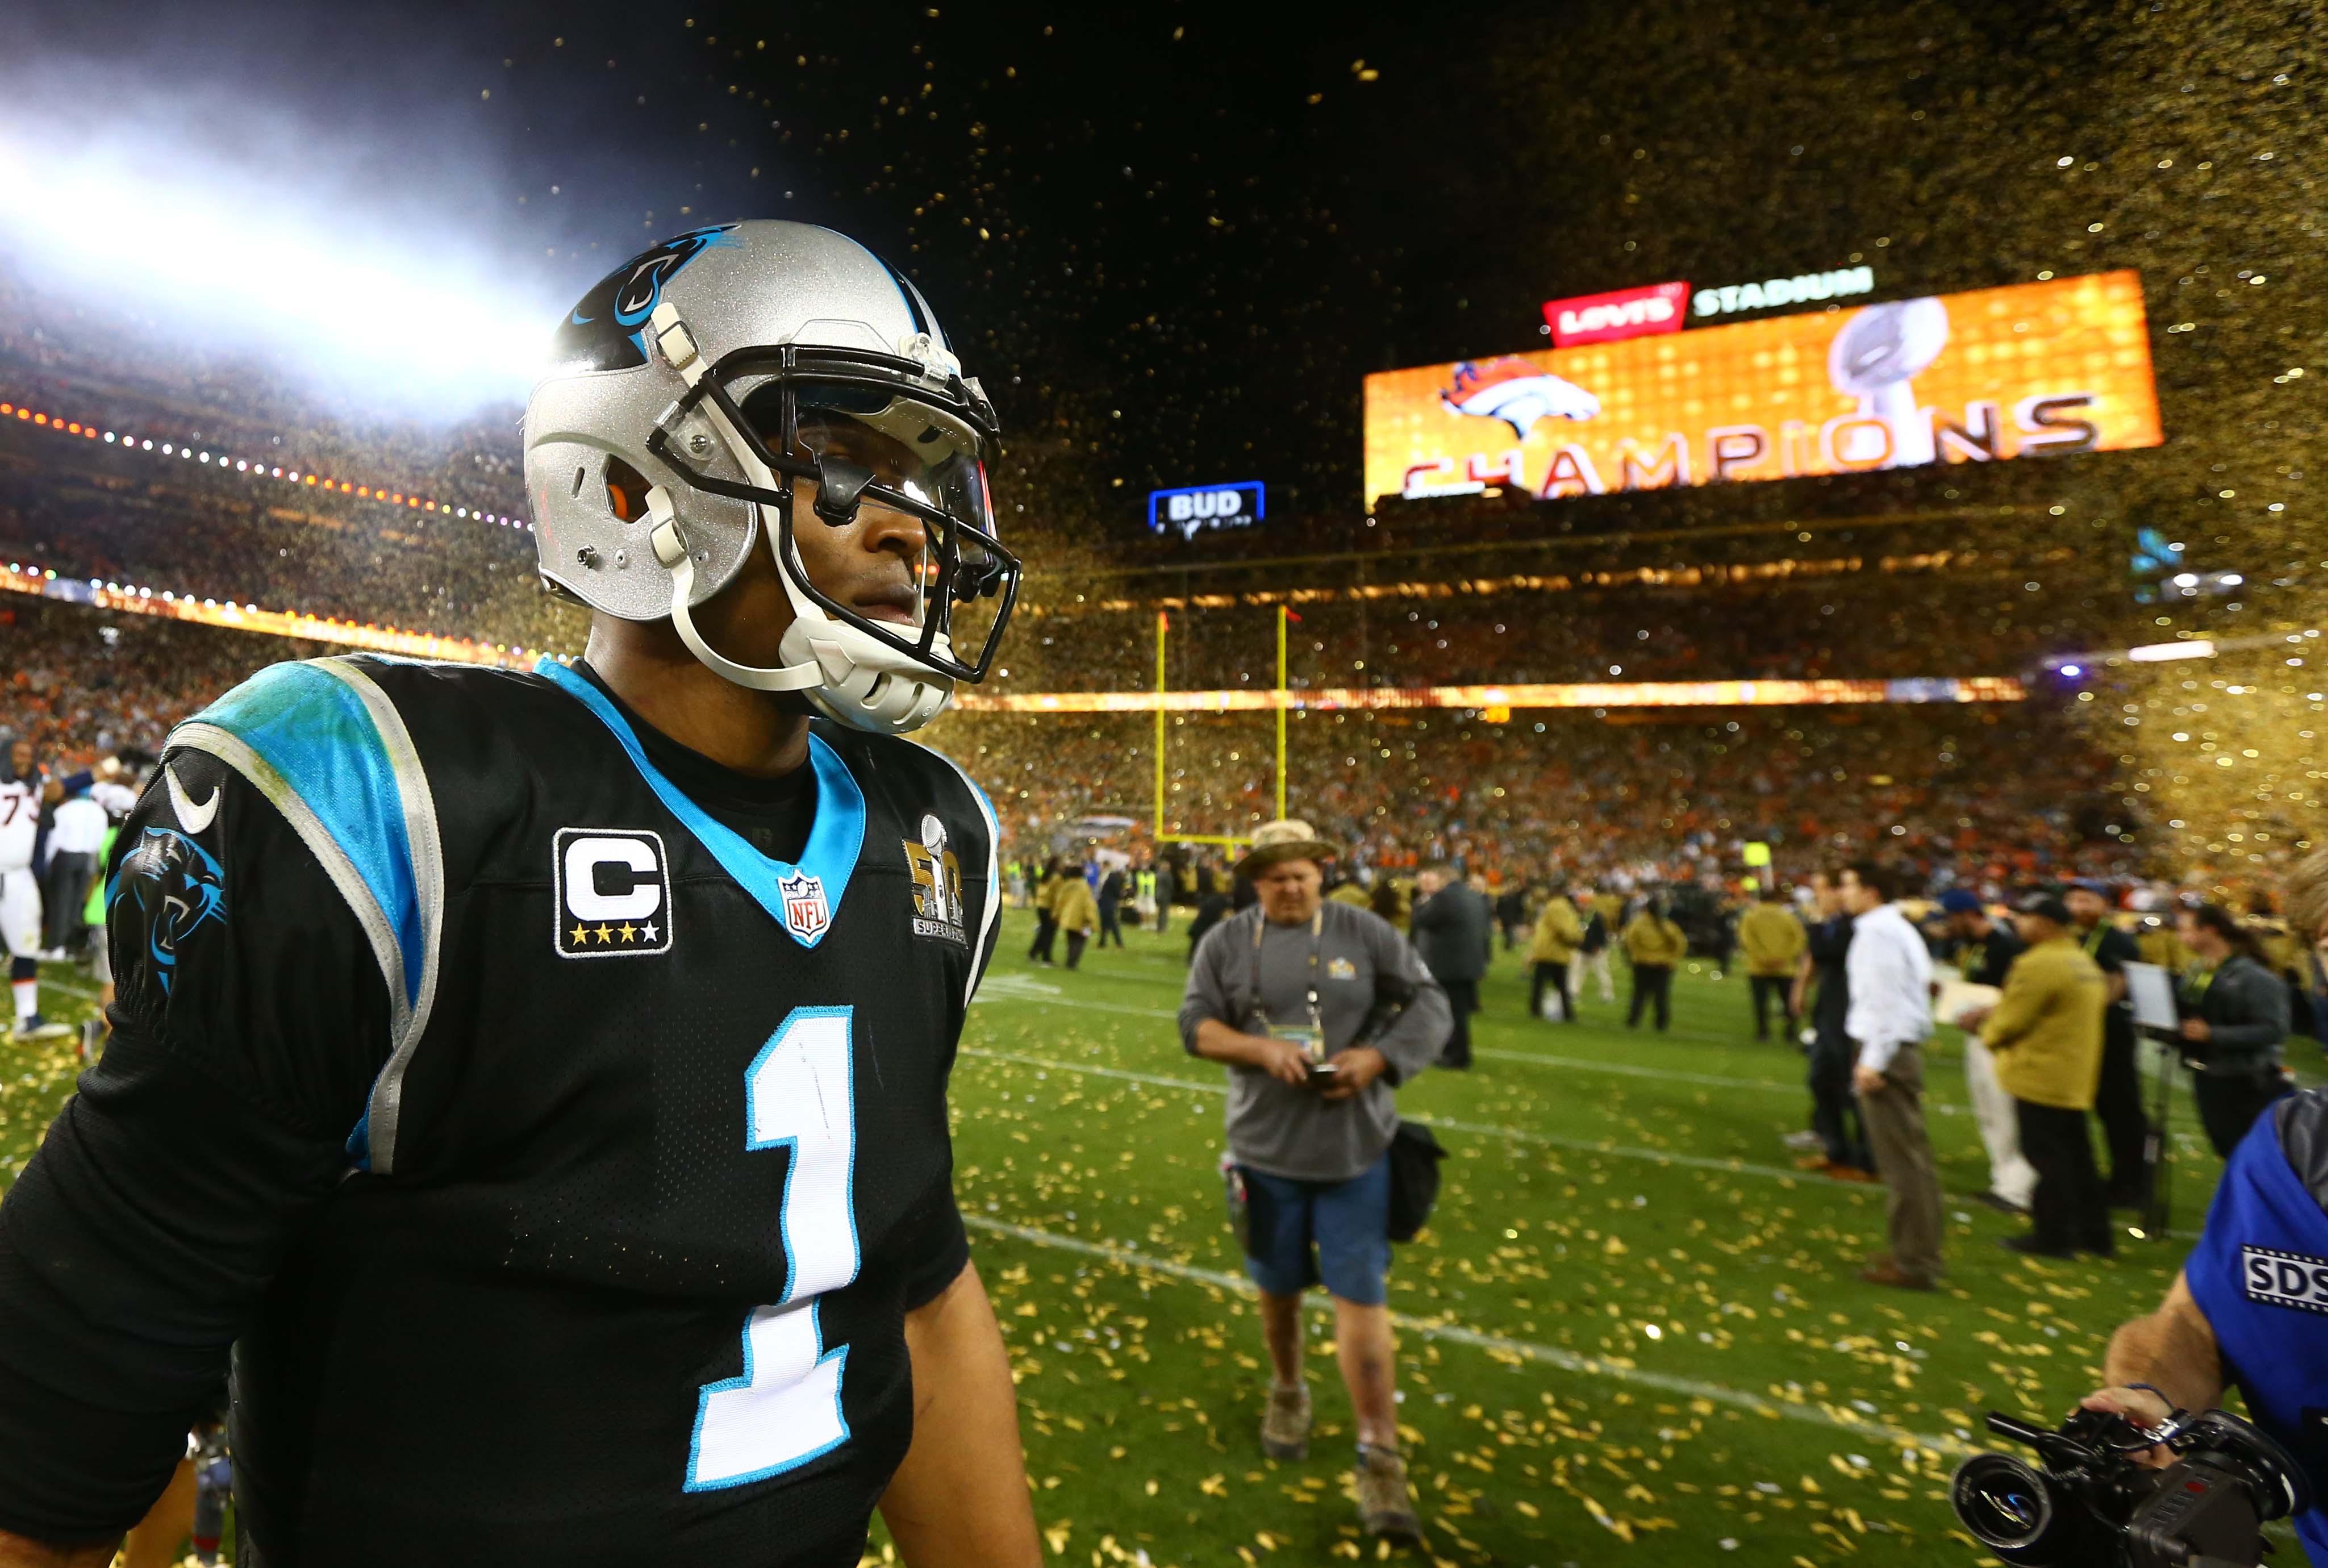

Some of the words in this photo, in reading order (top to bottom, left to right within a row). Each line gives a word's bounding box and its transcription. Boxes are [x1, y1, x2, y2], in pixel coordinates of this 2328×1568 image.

[1693, 266, 1874, 316] STADIUM
[1402, 392, 2100, 501] CHAMPIONS
[1169, 490, 1242, 521] BUD
[565, 837, 661, 921] C
[791, 900, 824, 929] NFL
[682, 1004, 861, 1494] 1
[2249, 1257, 2328, 1303] SDS
